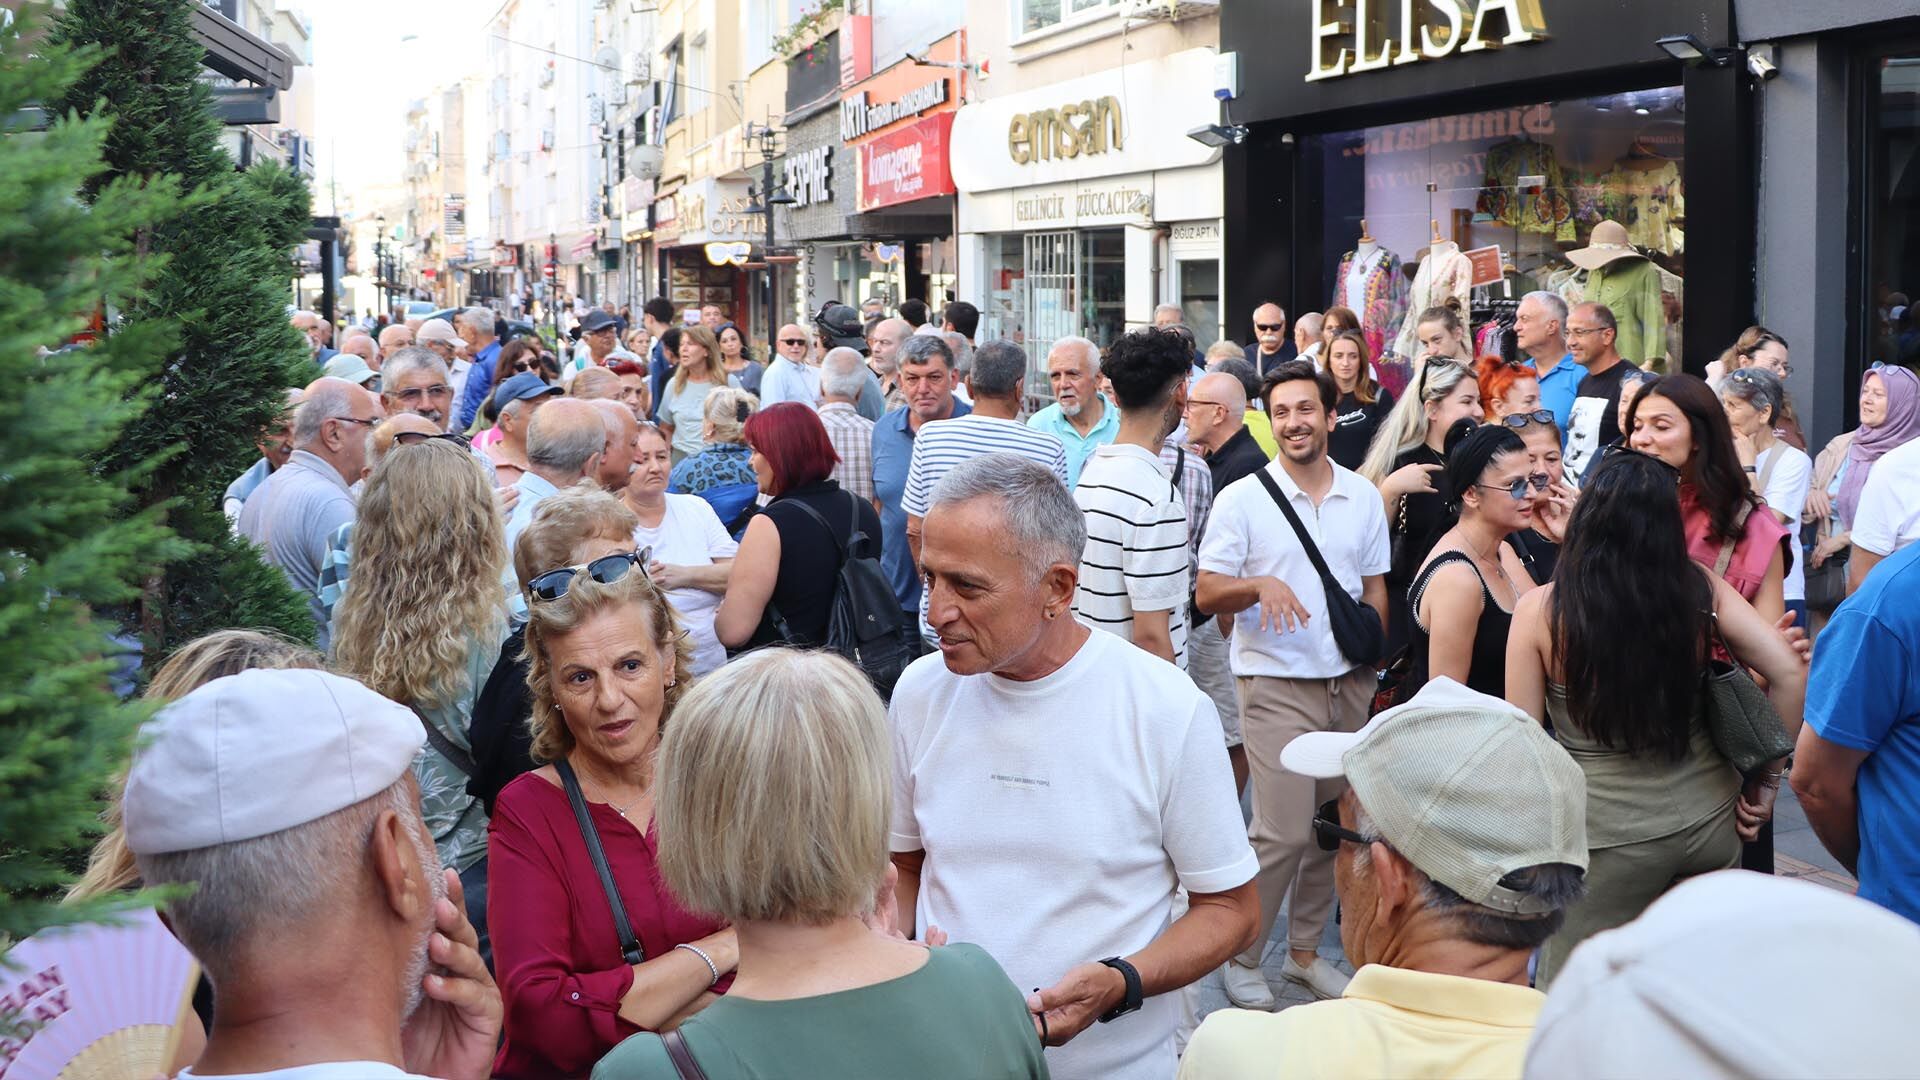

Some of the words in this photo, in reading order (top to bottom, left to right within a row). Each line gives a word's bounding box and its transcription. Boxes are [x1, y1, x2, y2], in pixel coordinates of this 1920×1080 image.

[1008, 96, 1123, 165] emsan
[868, 142, 922, 193] komagene
[1016, 193, 1065, 221] GELİNCİK
[1076, 186, 1141, 218] ZÜCCACİY
